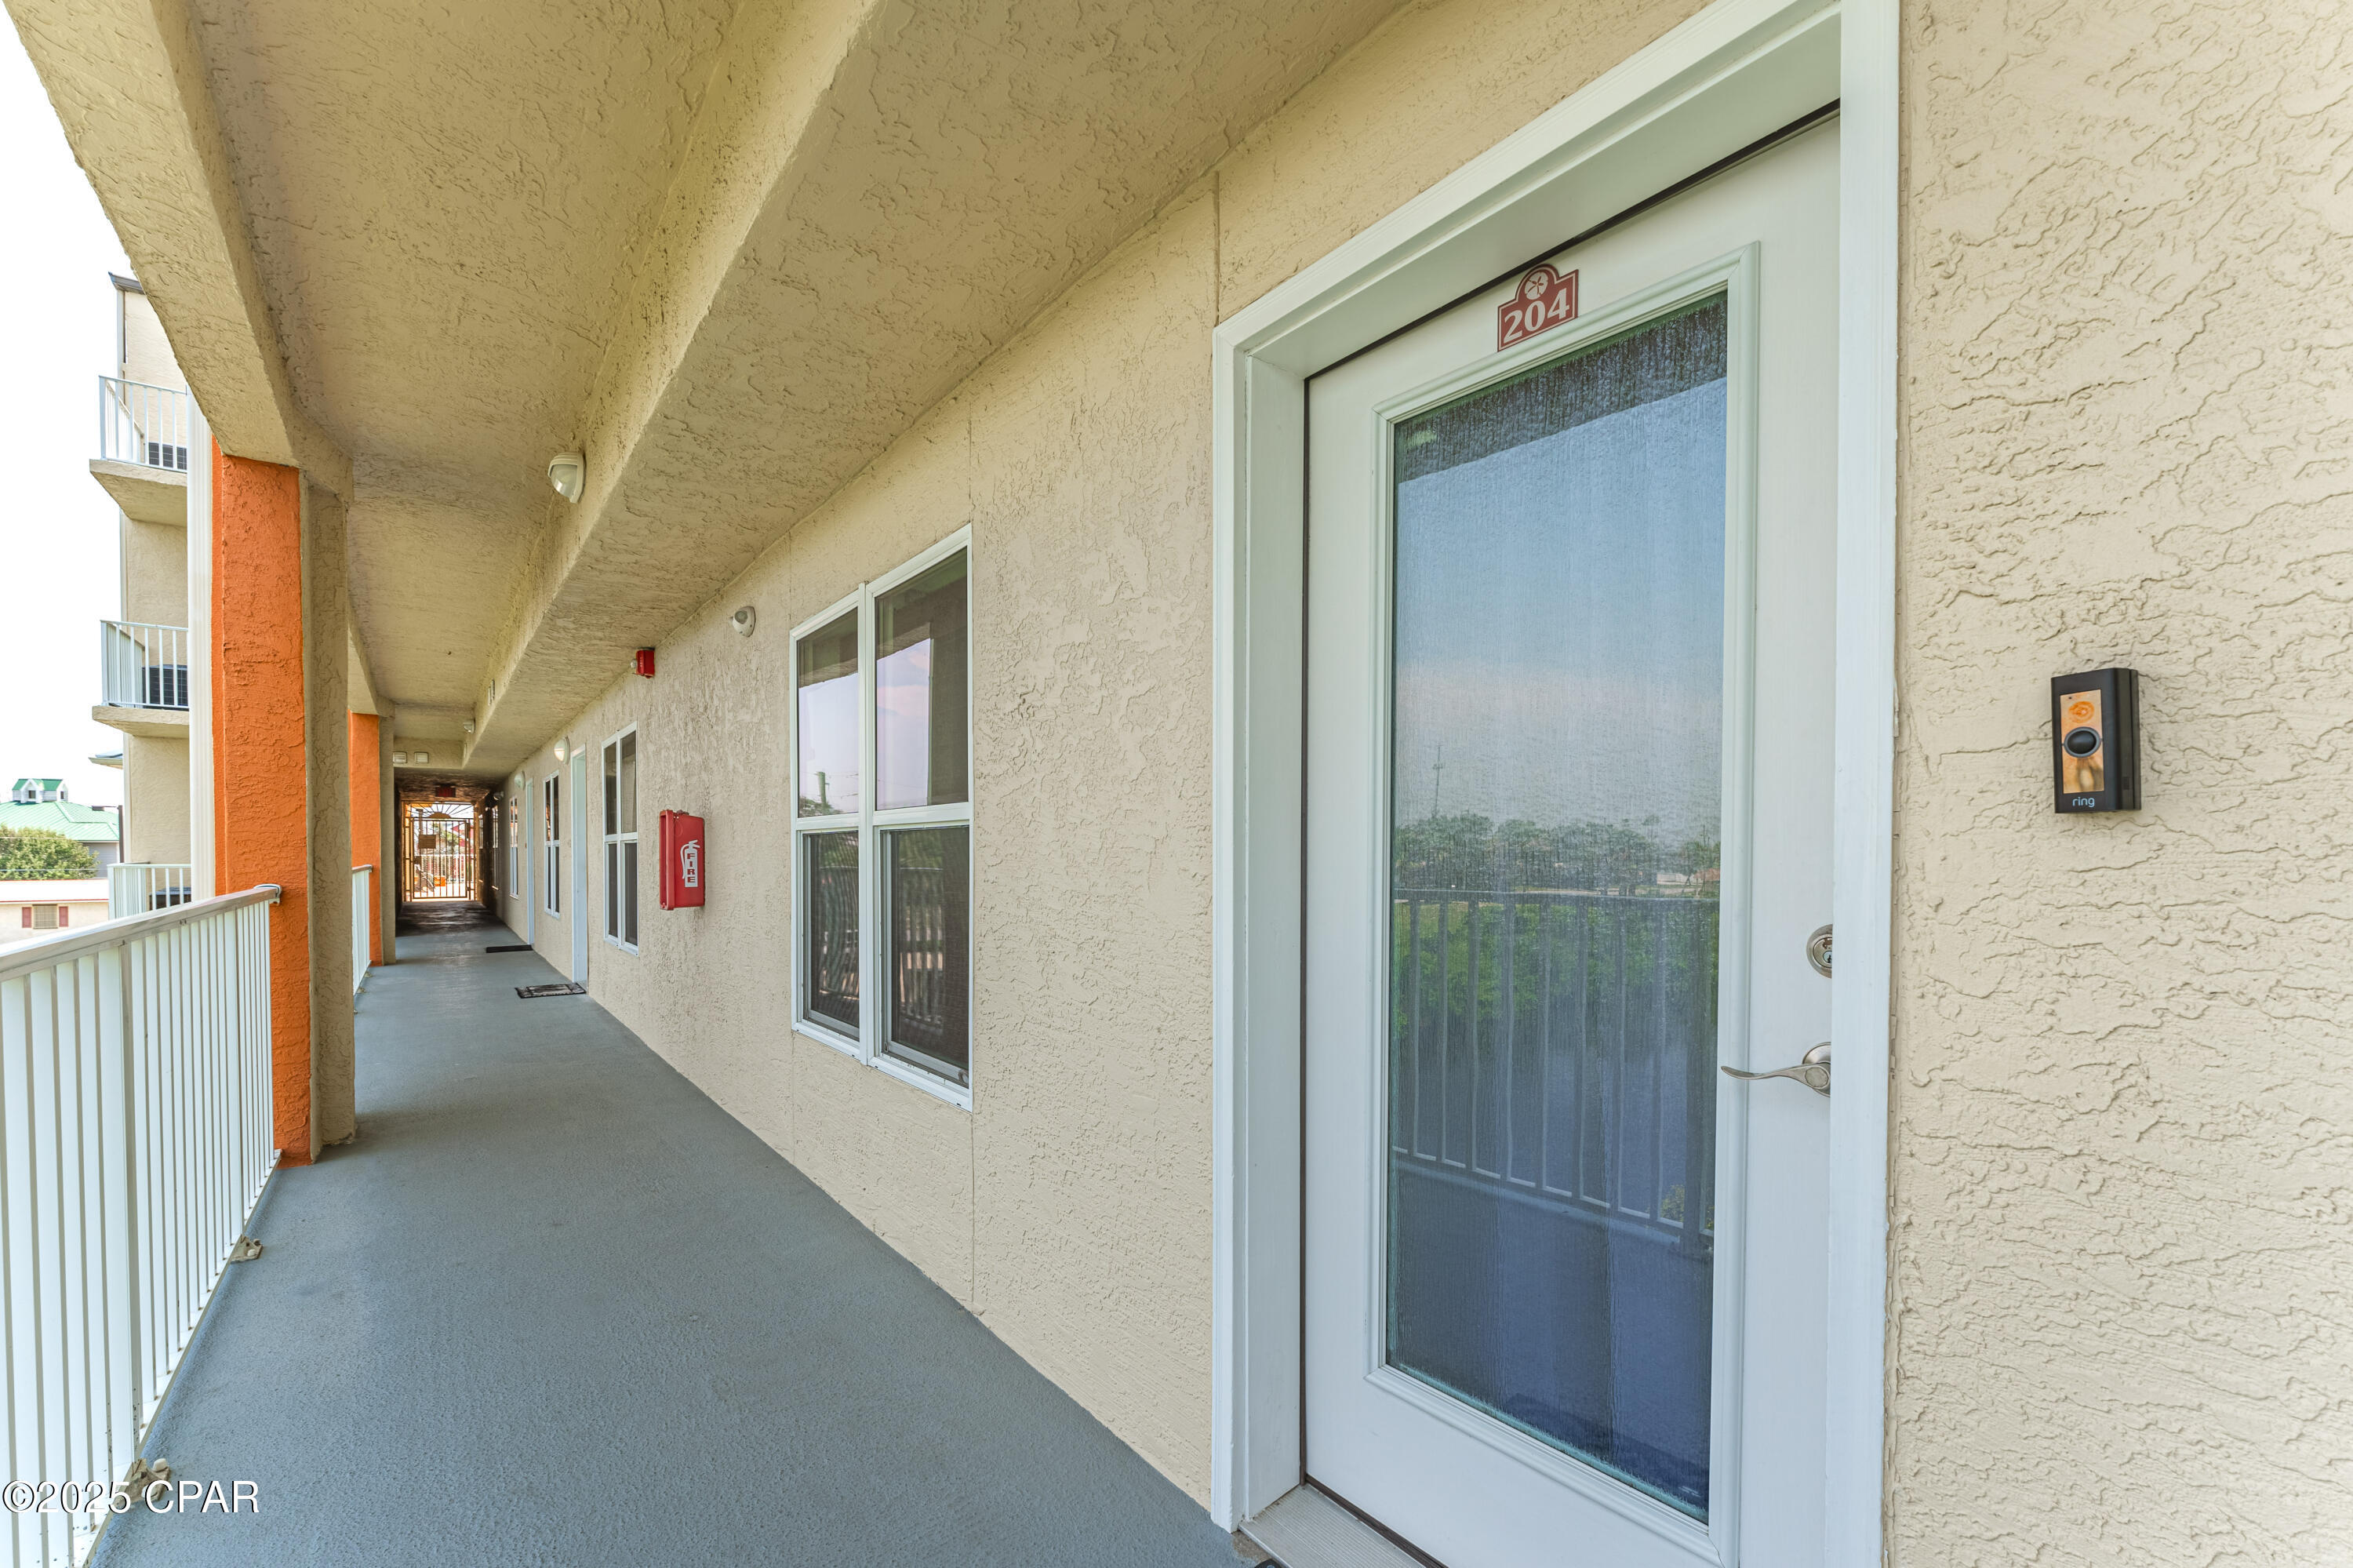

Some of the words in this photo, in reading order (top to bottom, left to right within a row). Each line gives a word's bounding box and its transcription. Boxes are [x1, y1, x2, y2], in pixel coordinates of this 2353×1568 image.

[1504, 288, 1569, 344] 204
[2072, 796, 2095, 808] ring
[686, 853, 696, 883] FIRE
